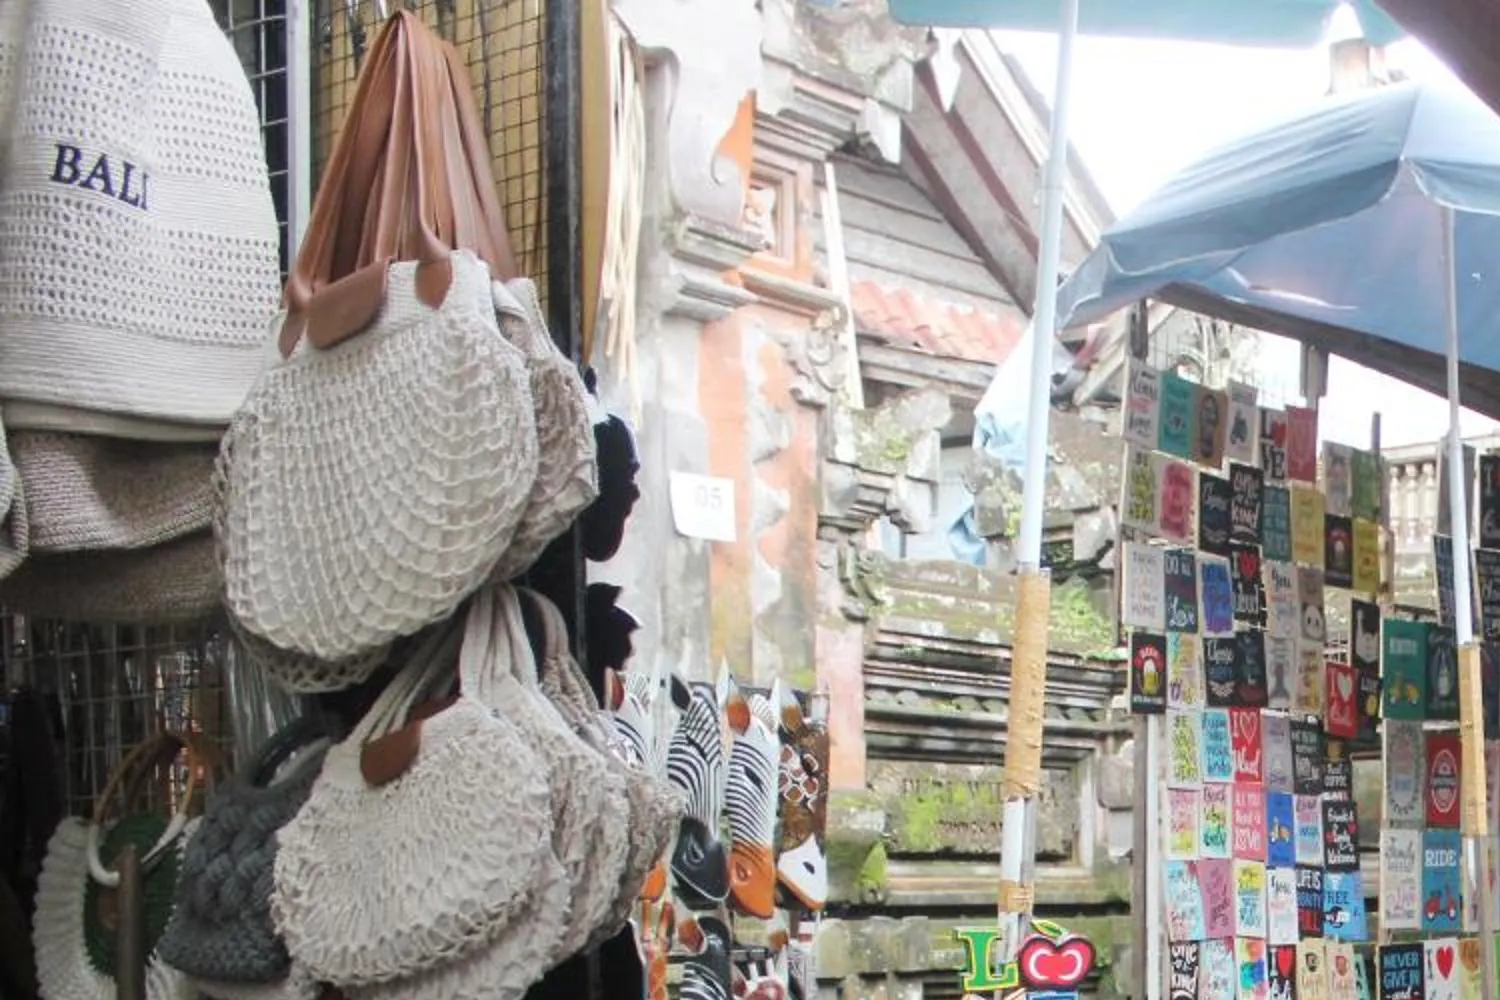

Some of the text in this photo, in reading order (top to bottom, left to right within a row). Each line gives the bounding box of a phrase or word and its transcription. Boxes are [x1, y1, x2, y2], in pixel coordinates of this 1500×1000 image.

[49, 143, 149, 211] BALI
[1425, 849, 1457, 867] RIDE
[1383, 952, 1420, 967] NEVER
